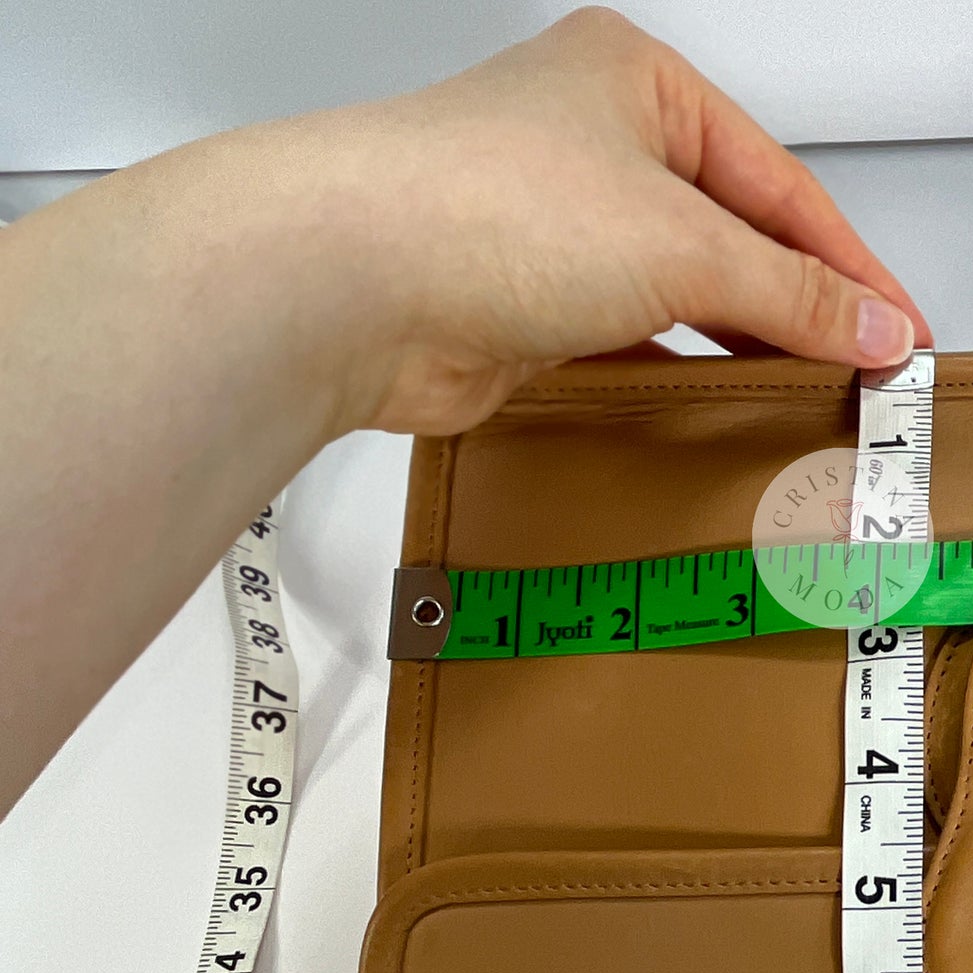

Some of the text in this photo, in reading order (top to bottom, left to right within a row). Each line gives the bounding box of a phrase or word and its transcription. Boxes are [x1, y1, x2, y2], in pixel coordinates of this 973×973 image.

[869, 434, 907, 448] 1
[863, 515, 903, 539] 2
[239, 565, 273, 602] 39
[848, 584, 870, 614] 4
[610, 607, 633, 640] 2
[725, 593, 750, 627] 3
[249, 618, 284, 654] 38
[494, 616, 510, 647] 1
[534, 615, 594, 647] Jyoti
[858, 627, 898, 656] 3
[251, 680, 288, 734] 37
[861, 668, 872, 719] MADE IN
[857, 750, 899, 779] 4
[244, 776, 282, 826] 36
[860, 795, 872, 833] CHINA
[229, 865, 268, 913] 35
[855, 875, 897, 904] 5
